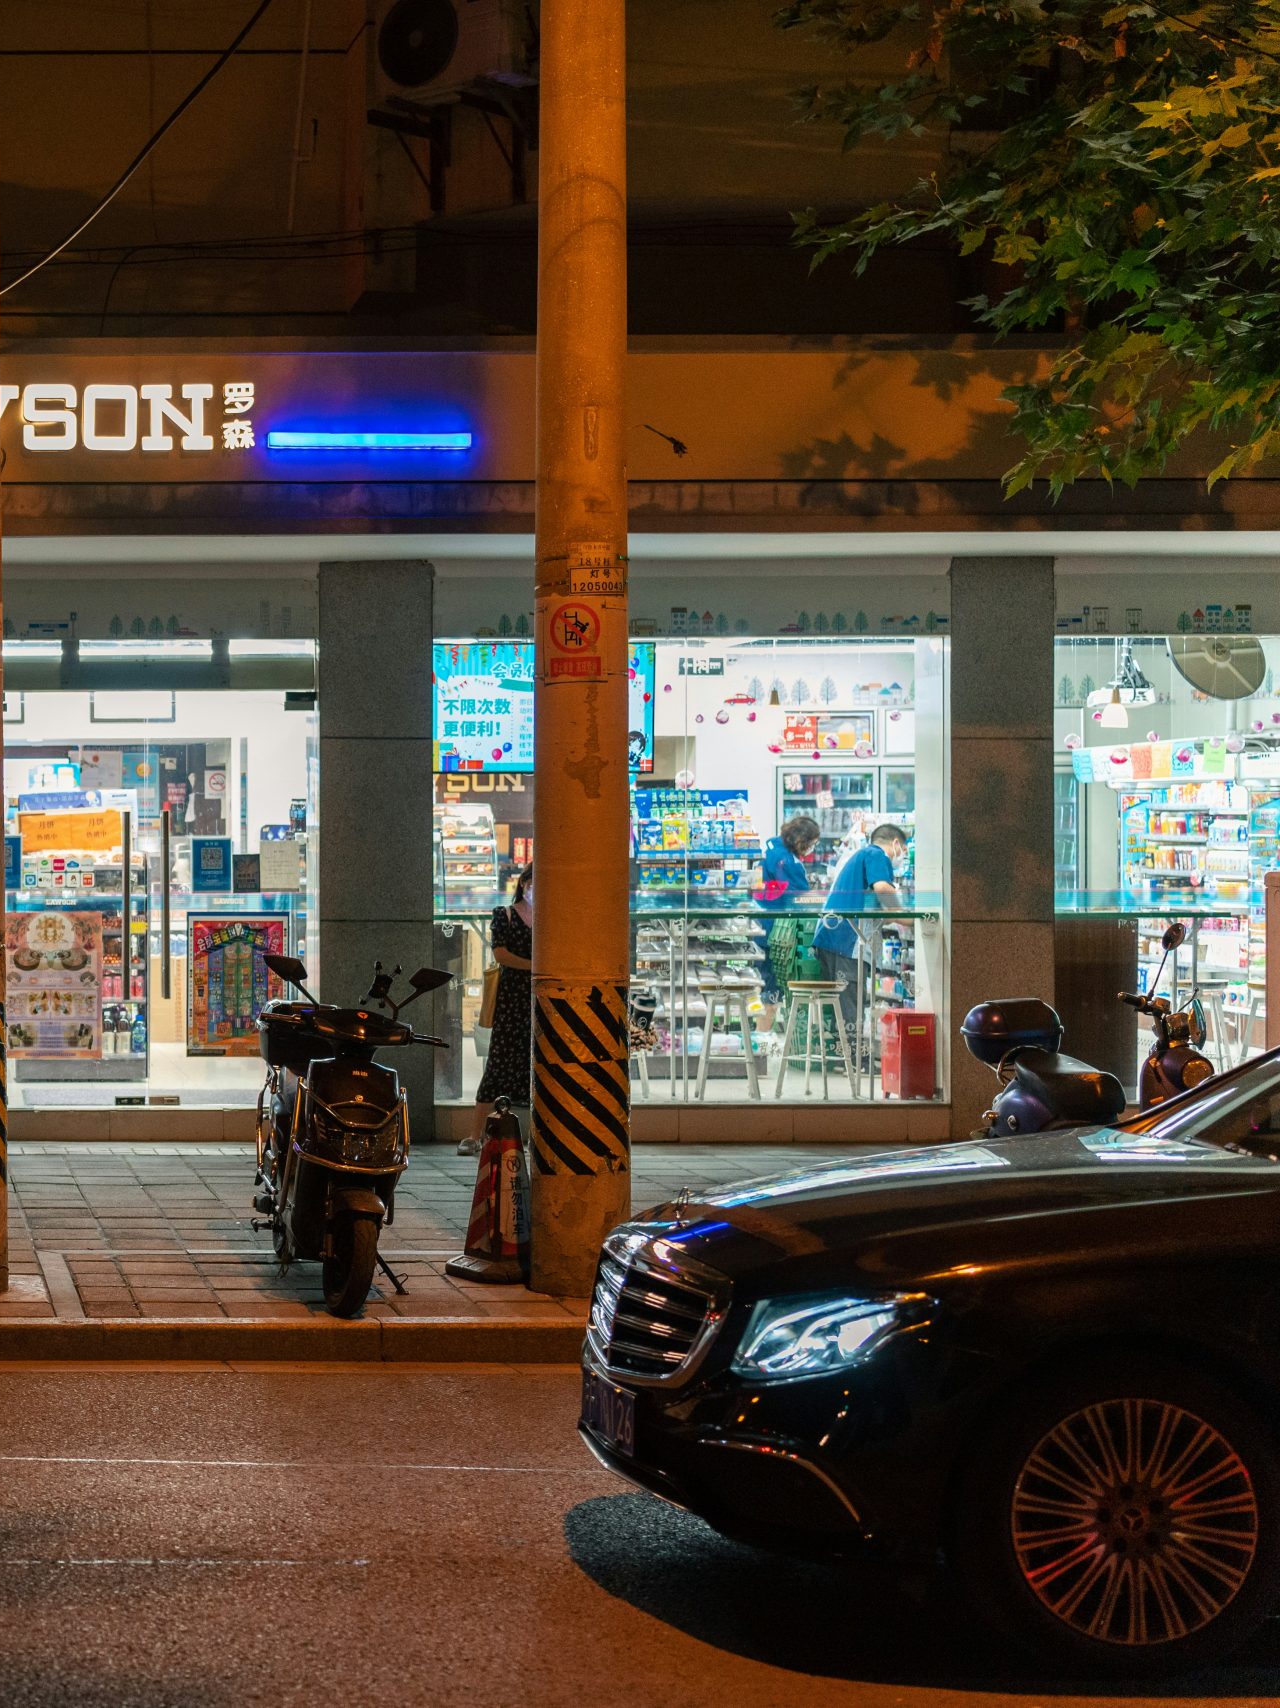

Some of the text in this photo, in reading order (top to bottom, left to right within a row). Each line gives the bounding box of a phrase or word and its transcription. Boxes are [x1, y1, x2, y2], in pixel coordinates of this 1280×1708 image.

[223, 383, 255, 449] 罗森
[590, 569, 610, 578] 灯号
[443, 699, 511, 715] 不限次数
